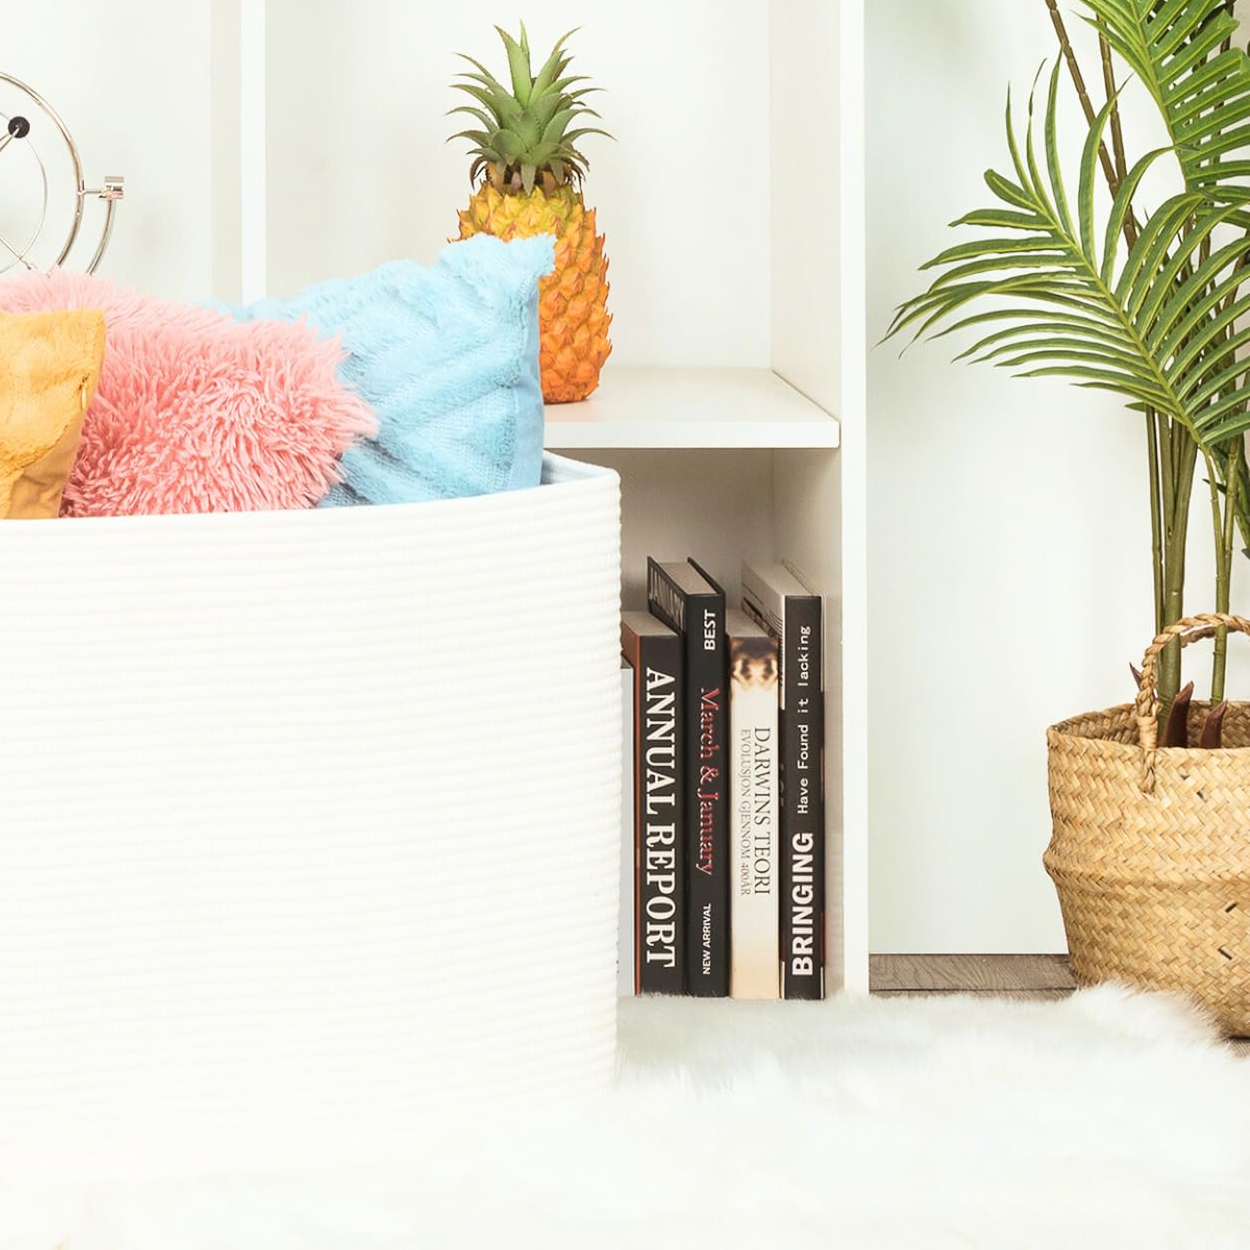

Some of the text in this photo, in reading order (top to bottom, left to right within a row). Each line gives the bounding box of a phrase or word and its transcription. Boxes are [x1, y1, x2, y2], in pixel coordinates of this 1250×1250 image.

[704, 609, 715, 650] BEST
[696, 688, 718, 875] March & January
[739, 729, 751, 796] EVOLUSJON
[797, 625, 811, 813] Have Found it lacking
[646, 667, 675, 967] ANNUAL REPORT
[739, 801, 750, 858] GJENNOM
[754, 728, 770, 894] DARWINS TEORI
[702, 903, 711, 975] NEW ARRIVAL
[791, 832, 814, 976] BRINGING
